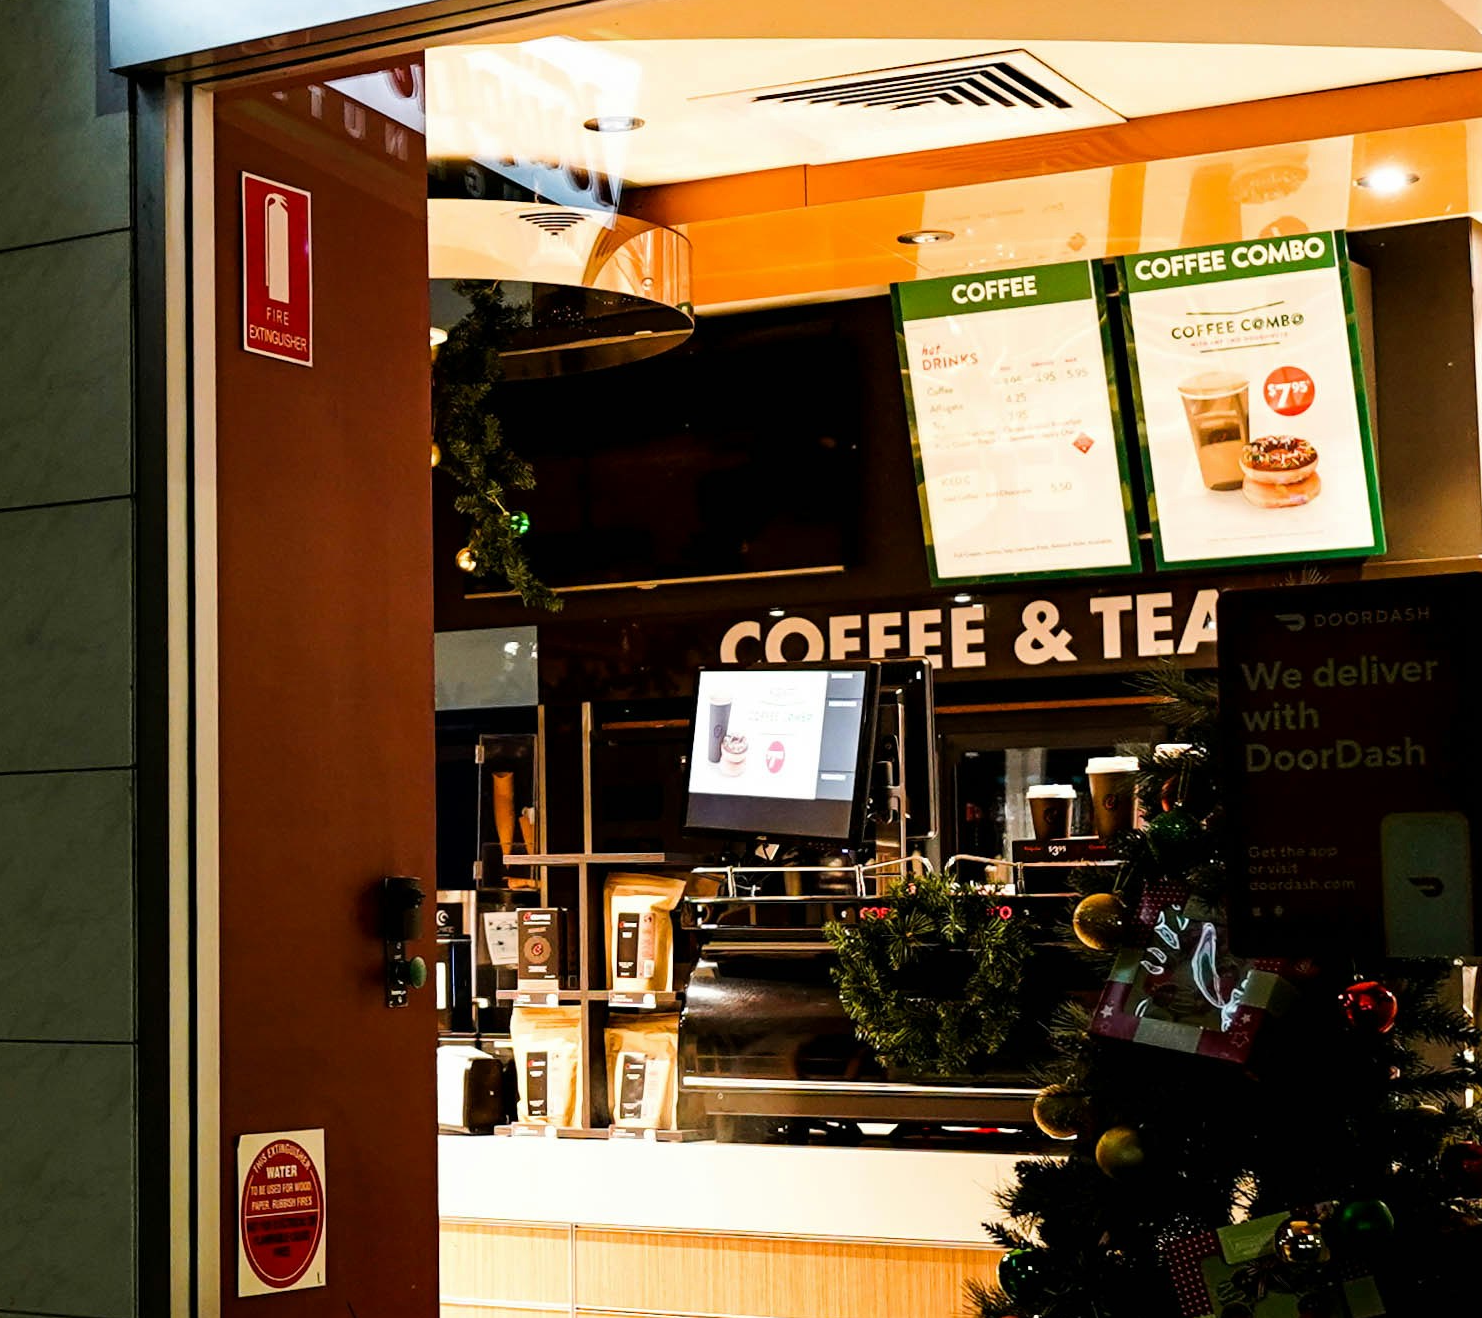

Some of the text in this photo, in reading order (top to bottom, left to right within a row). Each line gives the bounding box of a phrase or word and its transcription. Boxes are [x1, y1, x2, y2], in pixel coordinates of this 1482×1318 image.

[1134, 236, 1326, 282] COFFEE COMBO
[951, 274, 1038, 305] COFFEE
[266, 306, 290, 326] FIRE
[1171, 312, 1305, 340] COFFEE COMBO
[249, 323, 308, 353] EXTINGUISHER
[922, 352, 979, 372] DRINKS
[719, 588, 1218, 671] COFFEE & TEA
[1313, 606, 1431, 628] DOORDASH
[1240, 655, 1439, 692] We deliver
[1242, 700, 1320, 732] with
[1243, 735, 1427, 773] DoorDash
[266, 1164, 298, 1180] WATER
